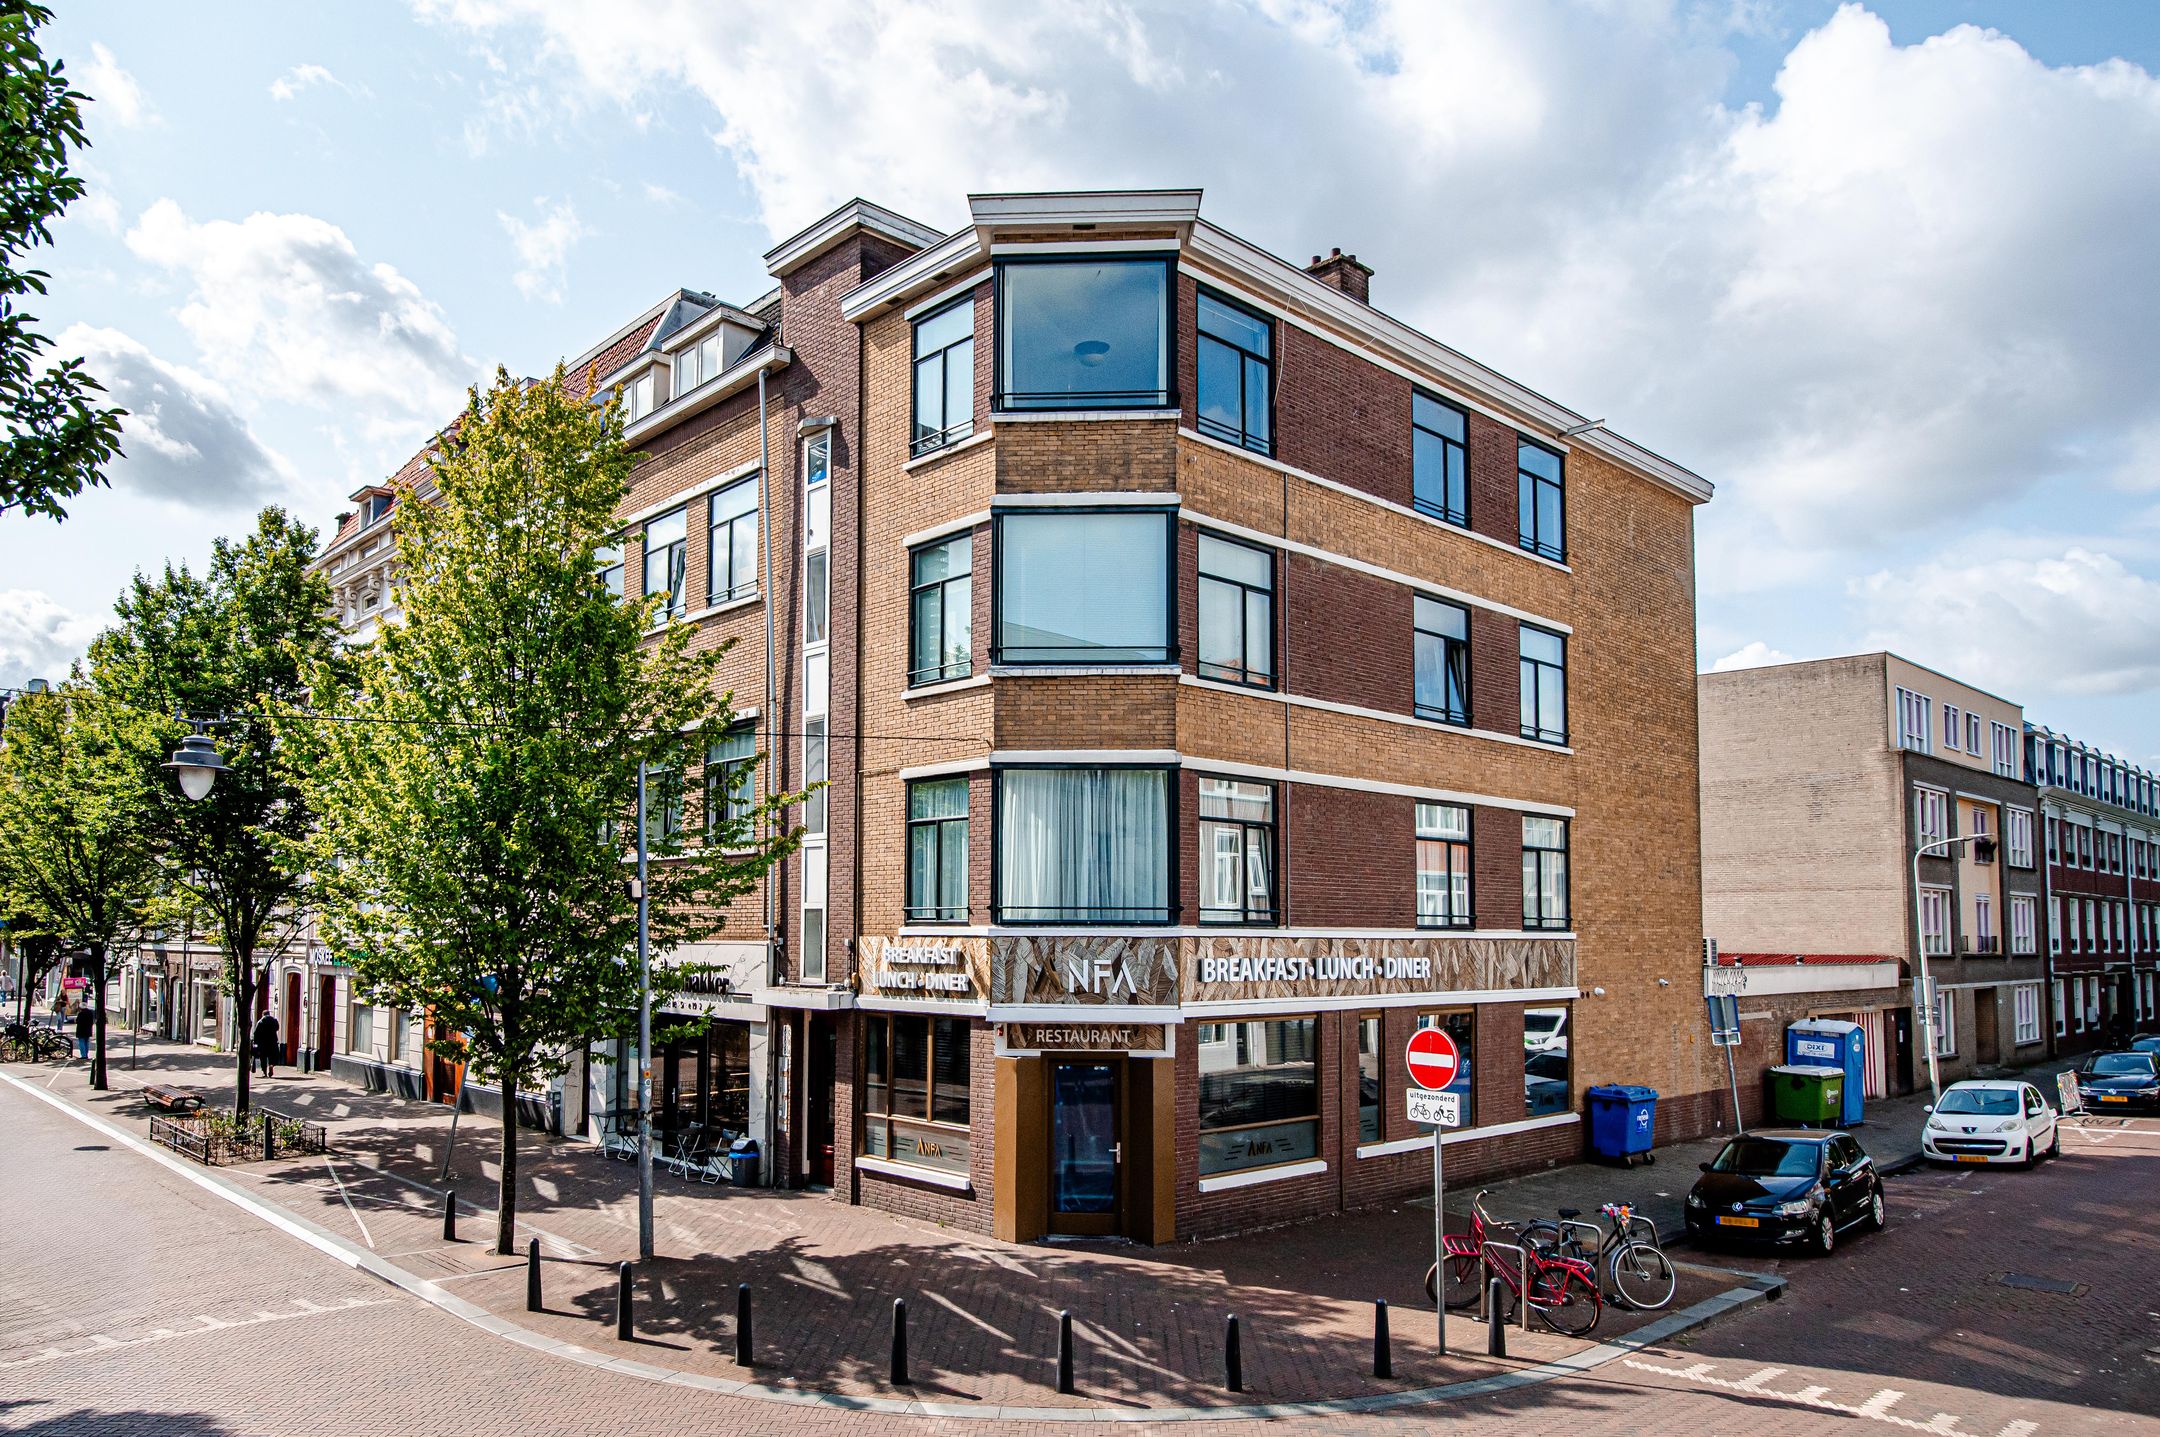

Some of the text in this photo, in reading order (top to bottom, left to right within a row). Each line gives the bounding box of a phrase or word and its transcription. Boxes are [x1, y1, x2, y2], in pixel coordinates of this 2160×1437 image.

[882, 946, 960, 965] BREAKFAST
[1201, 957, 1431, 983] BREAKFAST LUNCH DINER
[872, 971, 969, 991] LUNCH DINER
[1036, 1029, 1131, 1043] RESTAURANT
[1806, 1043, 1825, 1051] DIXI
[1409, 1092, 1456, 1103] uitgezonderd
[916, 1137, 943, 1158] ANFA
[1247, 1140, 1273, 1157] ANFA
